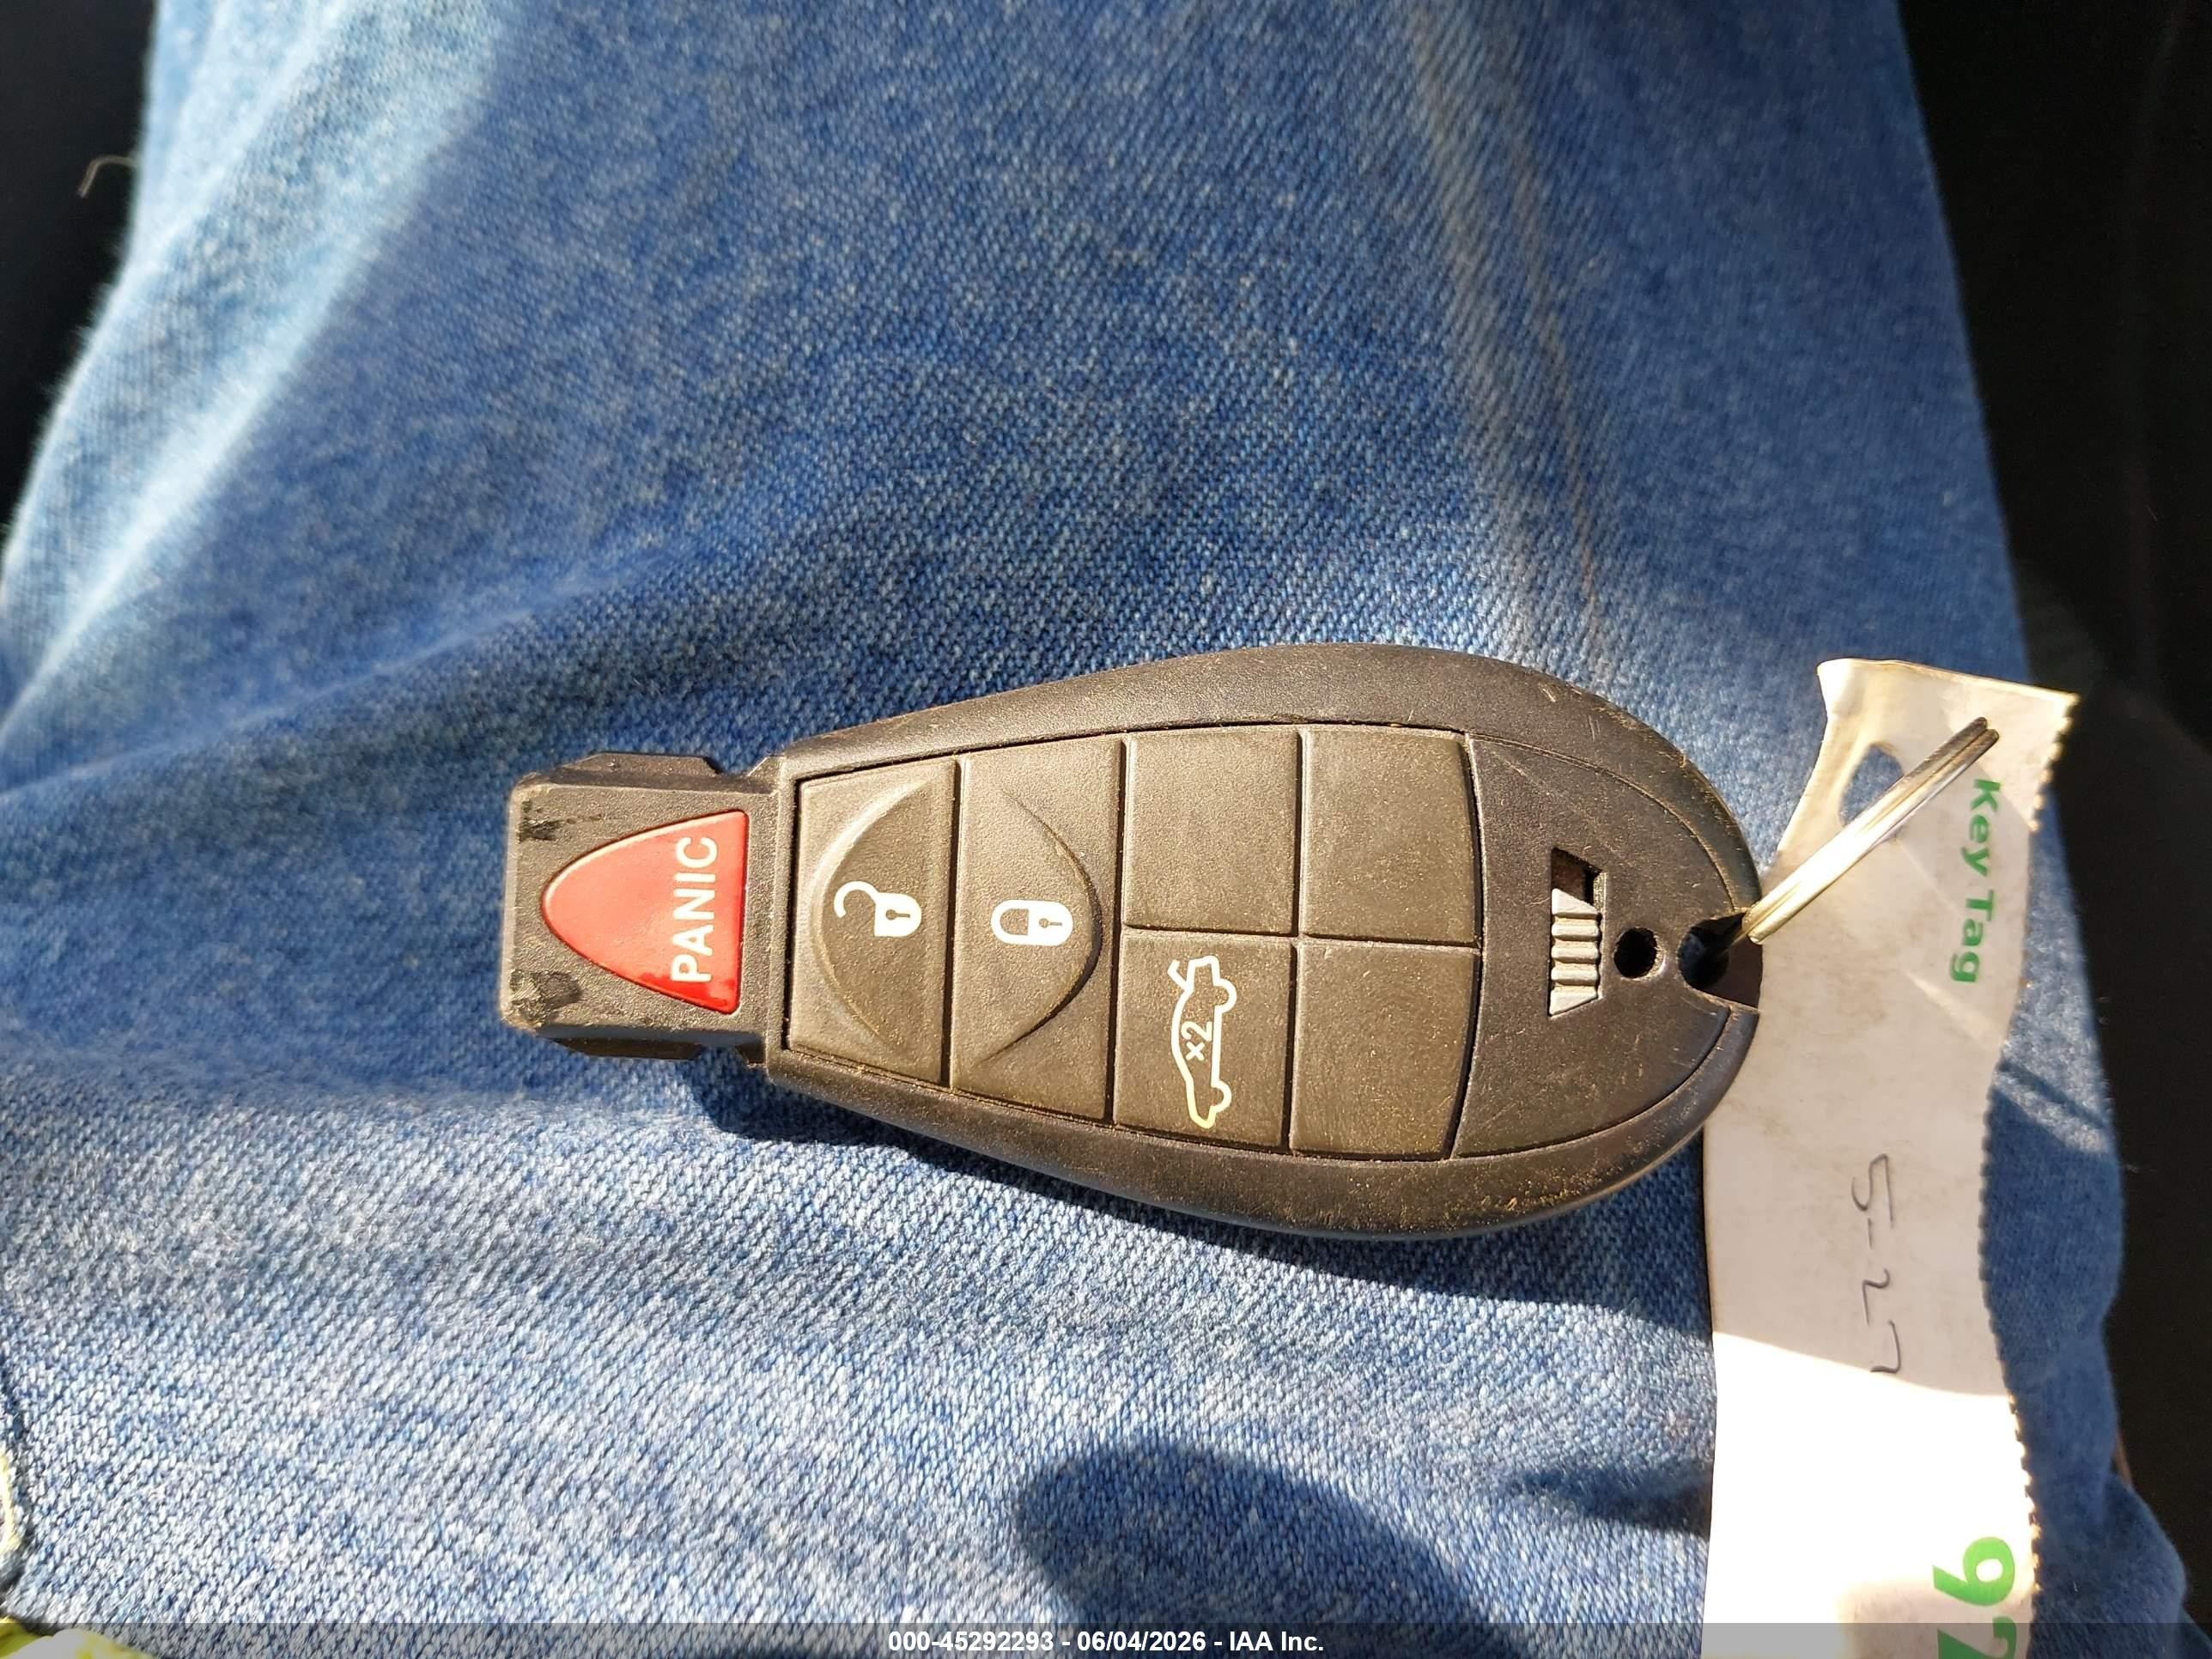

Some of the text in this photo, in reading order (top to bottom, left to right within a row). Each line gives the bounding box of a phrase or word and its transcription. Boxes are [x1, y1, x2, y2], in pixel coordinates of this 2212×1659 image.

[669, 836, 718, 983] PANIC
[1948, 777, 2001, 984] Key Tag
[1180, 1021, 1212, 1061] x2
